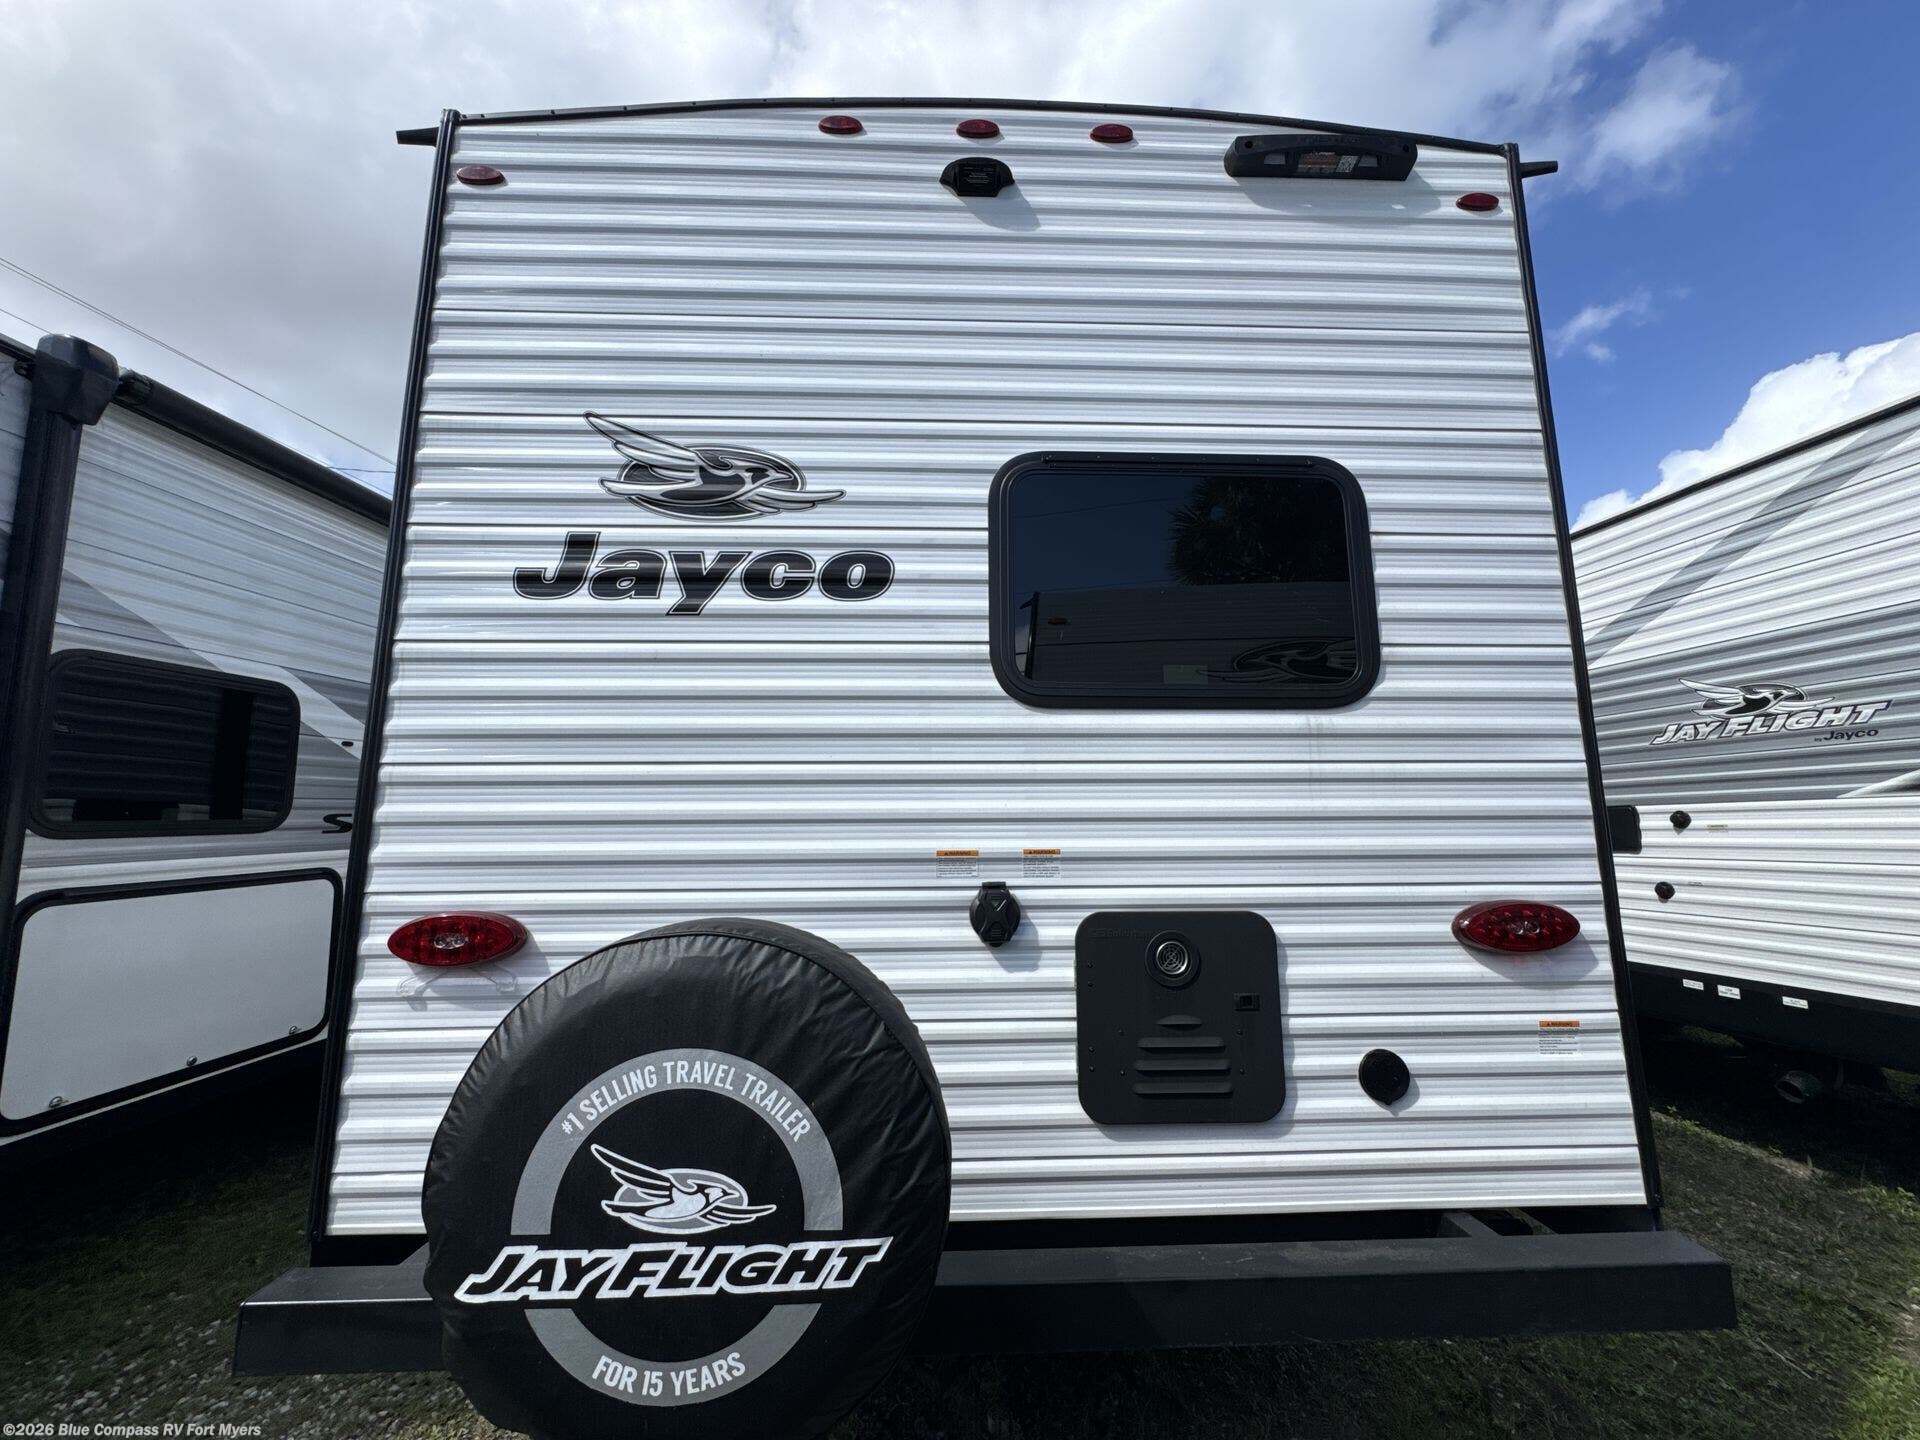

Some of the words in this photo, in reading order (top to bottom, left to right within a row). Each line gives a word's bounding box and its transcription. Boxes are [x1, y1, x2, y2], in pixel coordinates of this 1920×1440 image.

[512, 531, 896, 616] Jayco
[1823, 729, 1879, 741] Jayco
[561, 1112, 585, 1134] #1
[579, 1065, 658, 1121] SELLING
[662, 1060, 735, 1091] TRAVEL
[740, 1073, 811, 1142] TRAILER
[591, 1354, 636, 1394] FOR
[642, 1371, 664, 1397] 15
[670, 1352, 746, 1396] YEARS
